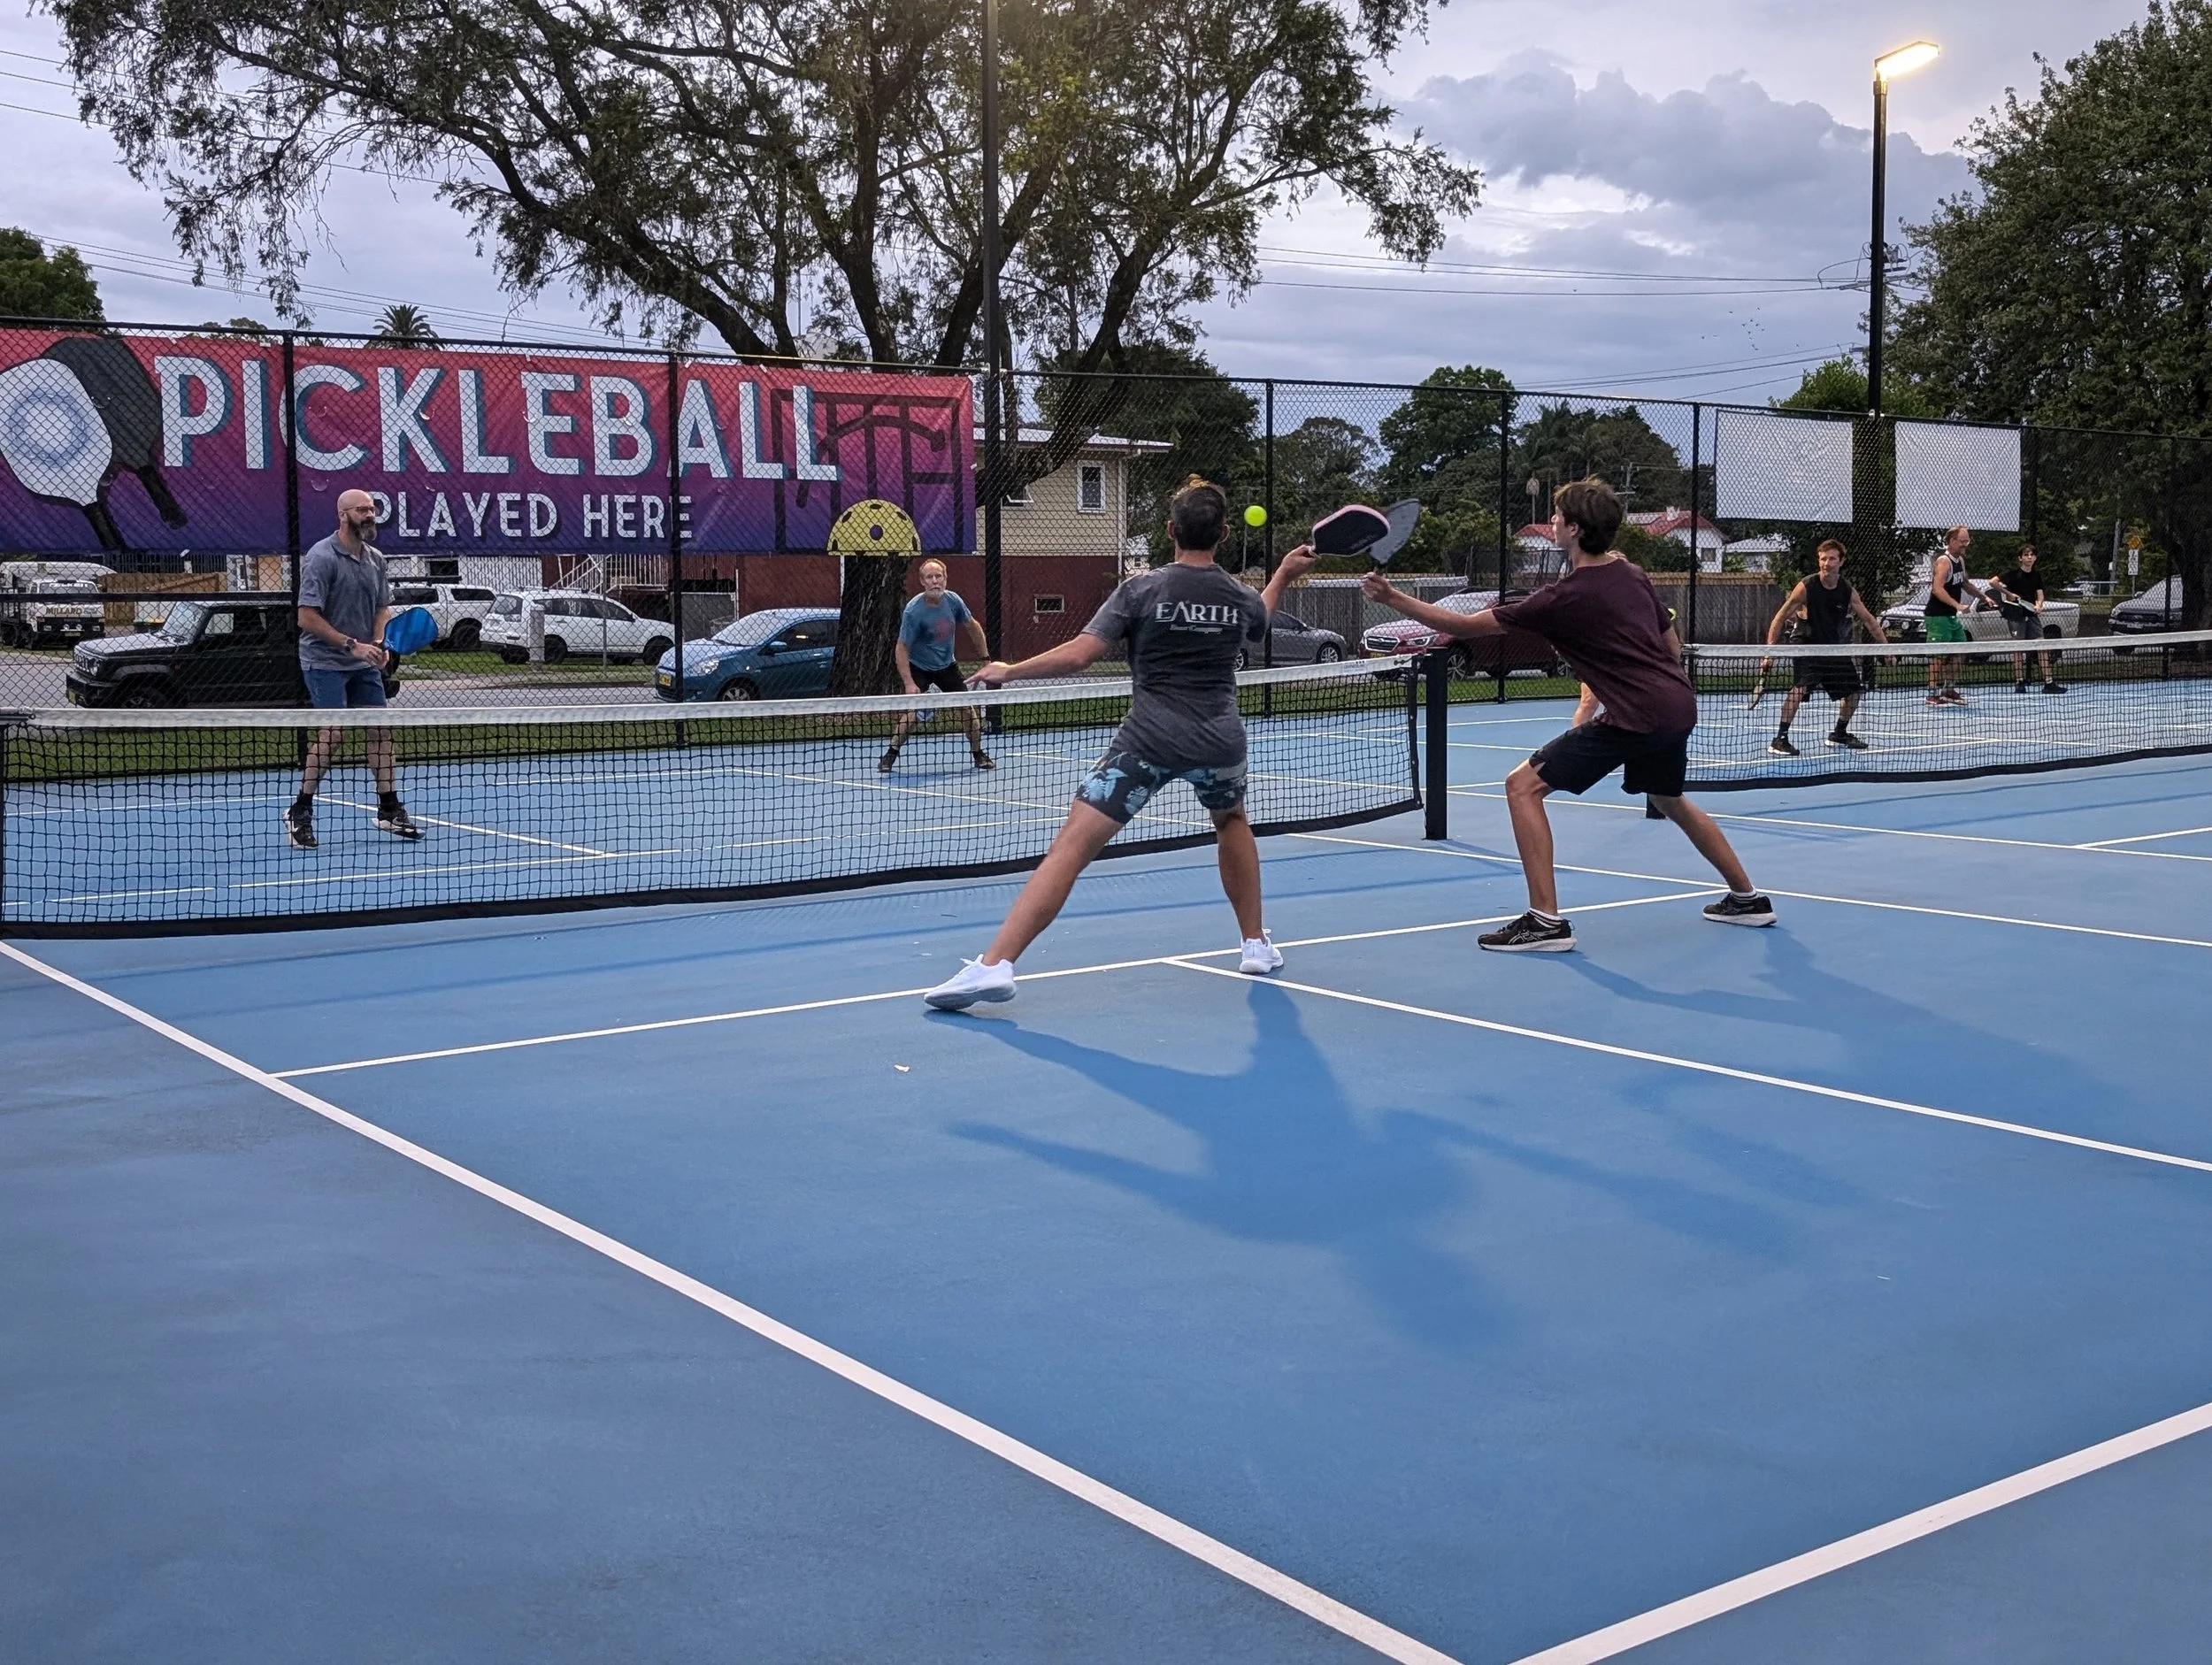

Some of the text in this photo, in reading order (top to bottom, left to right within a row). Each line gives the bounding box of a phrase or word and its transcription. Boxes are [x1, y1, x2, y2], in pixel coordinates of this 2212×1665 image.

[154, 355, 840, 481] PICKLEBALL
[582, 493, 694, 539] HERE
[1155, 602, 1239, 625] EARTH
